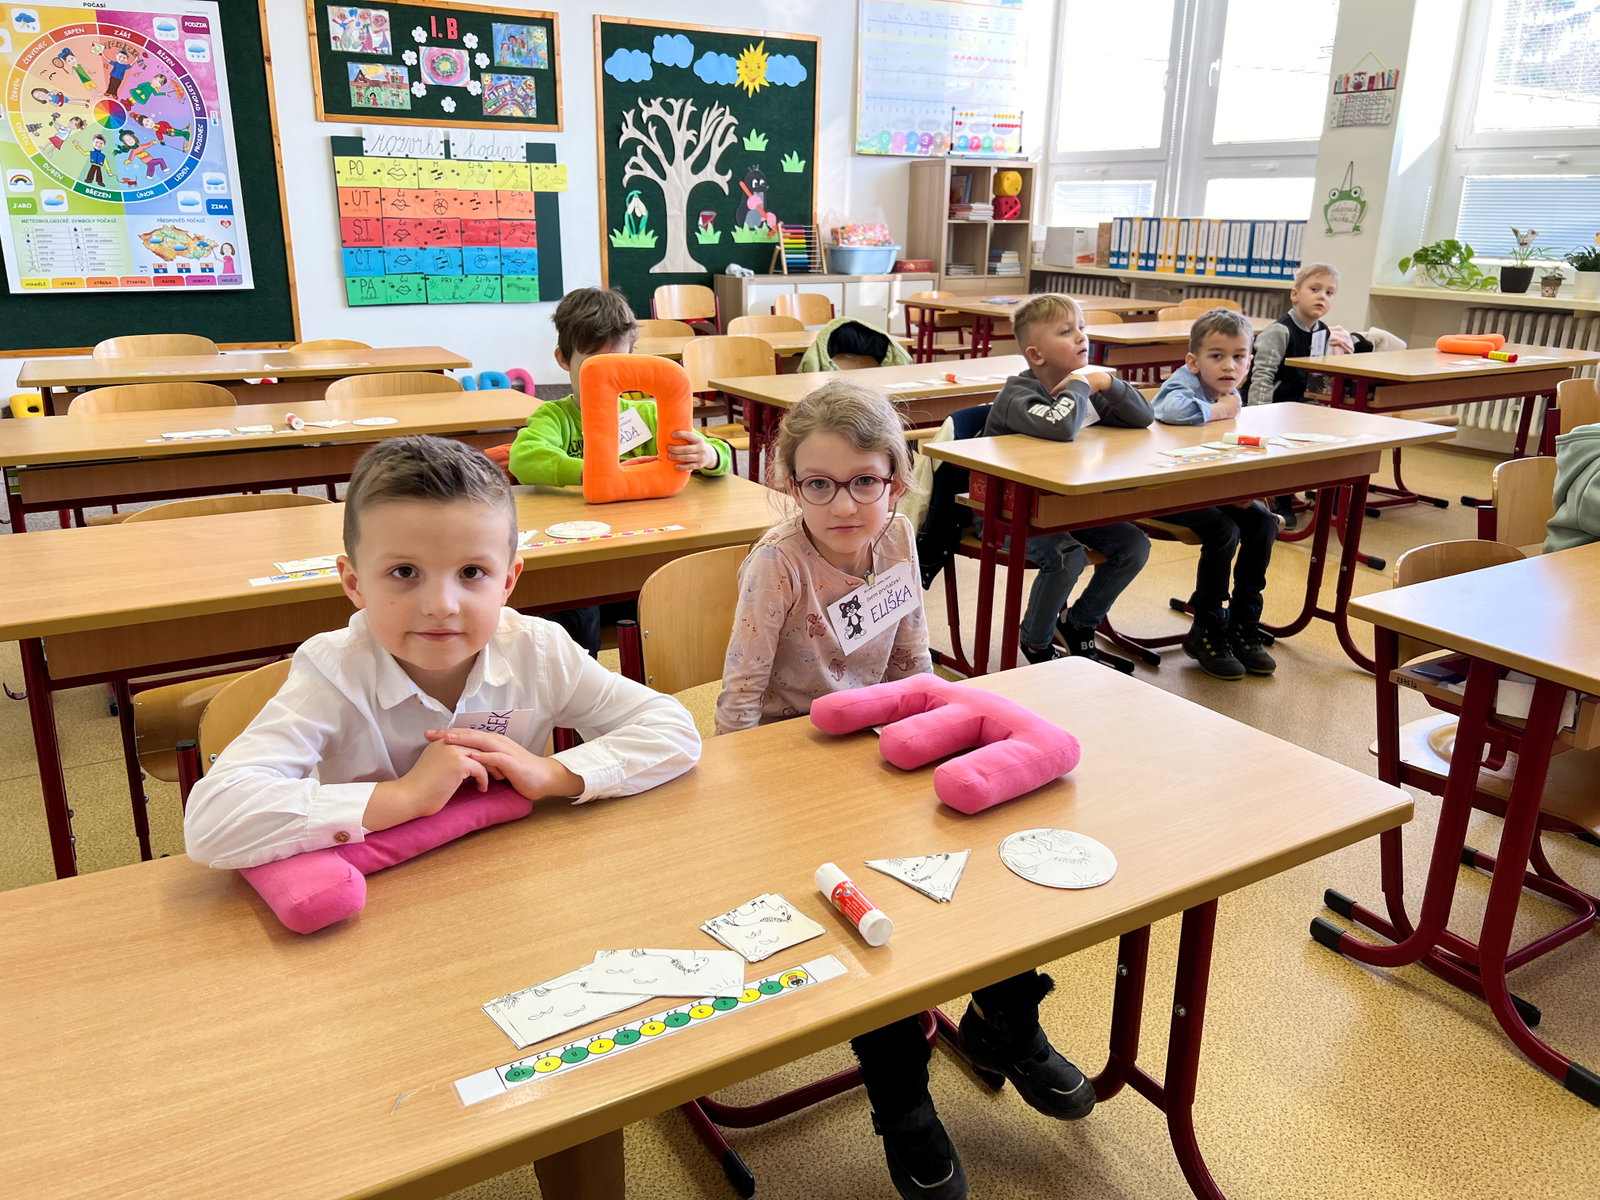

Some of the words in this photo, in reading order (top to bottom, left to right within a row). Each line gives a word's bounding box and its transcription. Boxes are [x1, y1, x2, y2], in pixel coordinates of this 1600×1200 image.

[64, 28, 85, 36] SRPEN
[114, 29, 132, 39] ZÁŘÍ
[23, 40, 48, 65] ČERVENEC
[185, 82, 201, 111] LISTOPAD
[194, 124, 204, 153] PROSINEC
[371, 130, 442, 154] rozvrh
[463, 132, 519, 158] hodin
[42, 163, 64, 180] DUBEN
[174, 166, 190, 182] LEDEN
[349, 160, 364, 176] PO
[85, 188, 112, 199] BŘEZEN
[136, 190, 155, 198] ÚNOR
[352, 189, 371, 206] ÚT
[353, 219, 371, 238] ST
[360, 276, 377, 298] PÁ
[870, 585, 913, 624] ELIŠKA
[478, 709, 514, 736] ŠEK
[513, 1069, 526, 1077] 10
